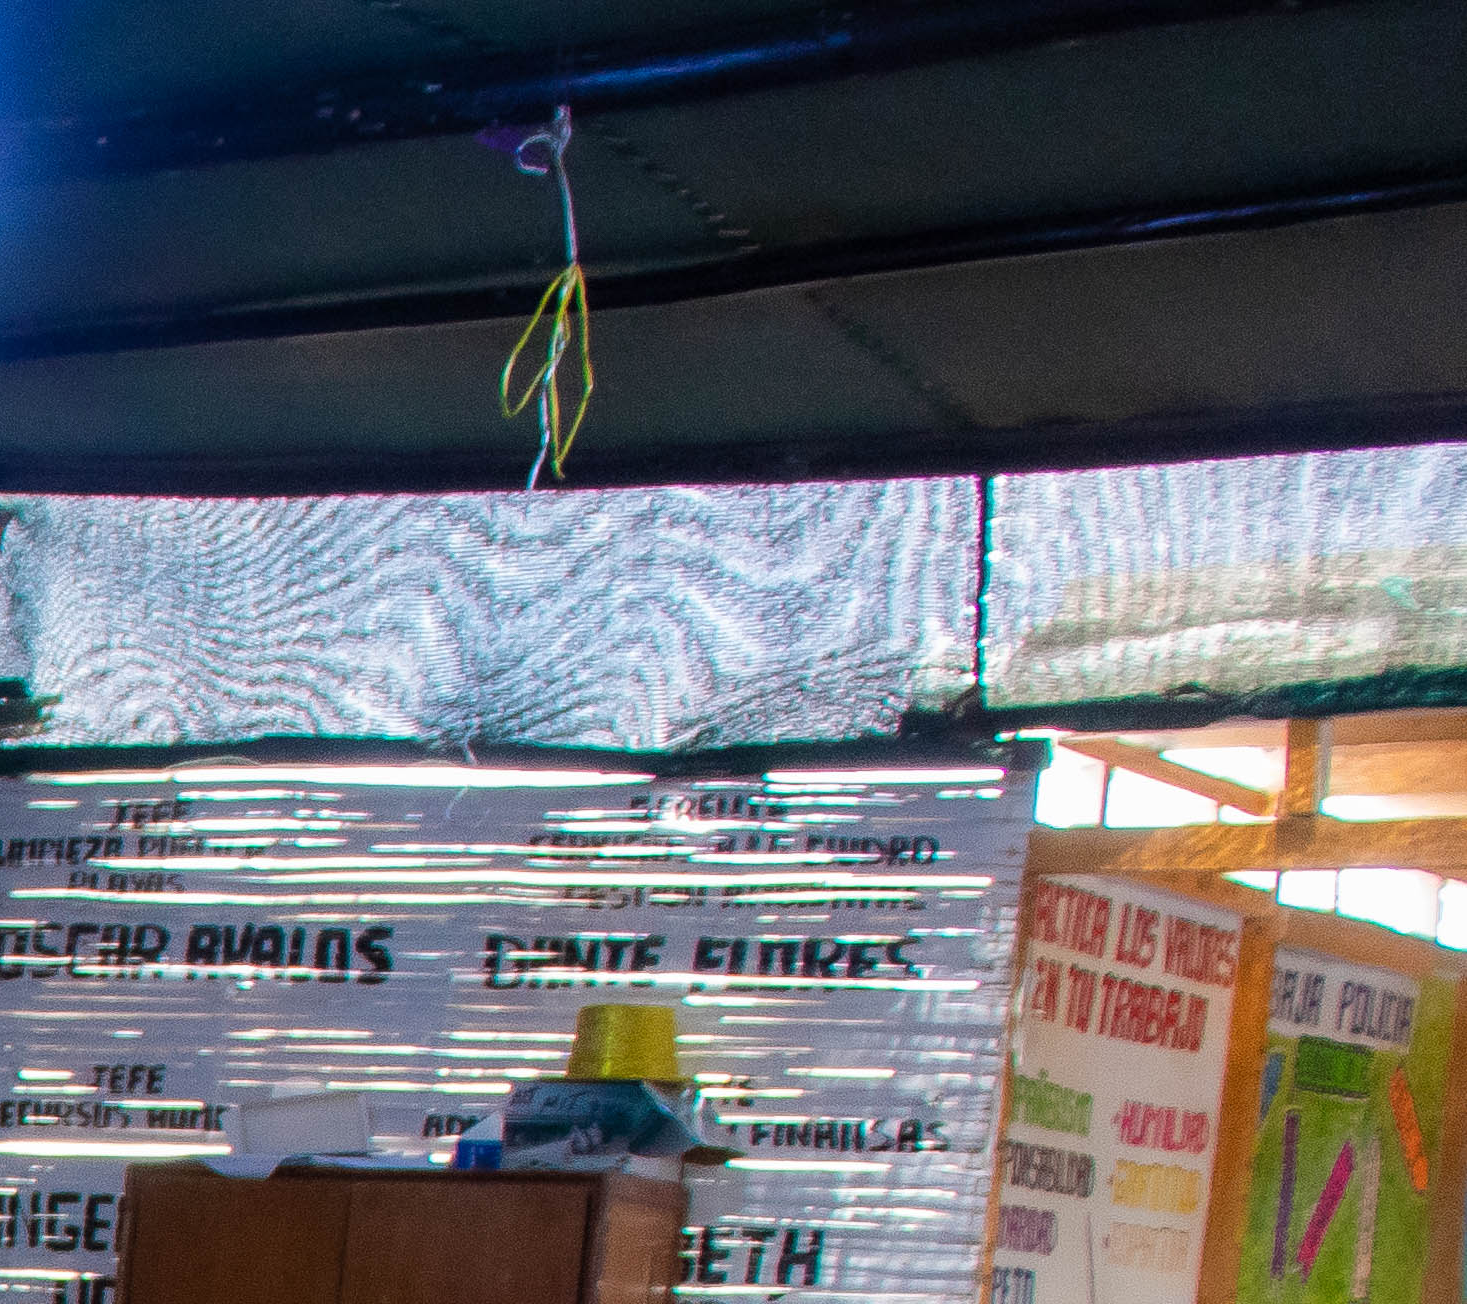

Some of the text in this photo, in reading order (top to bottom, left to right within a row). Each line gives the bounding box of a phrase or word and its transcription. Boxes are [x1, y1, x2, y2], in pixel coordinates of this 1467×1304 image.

[186, 922, 396, 985] AVALOS
[481, 932, 666, 989] DANTE
[88, 1064, 167, 1094] JEFE
